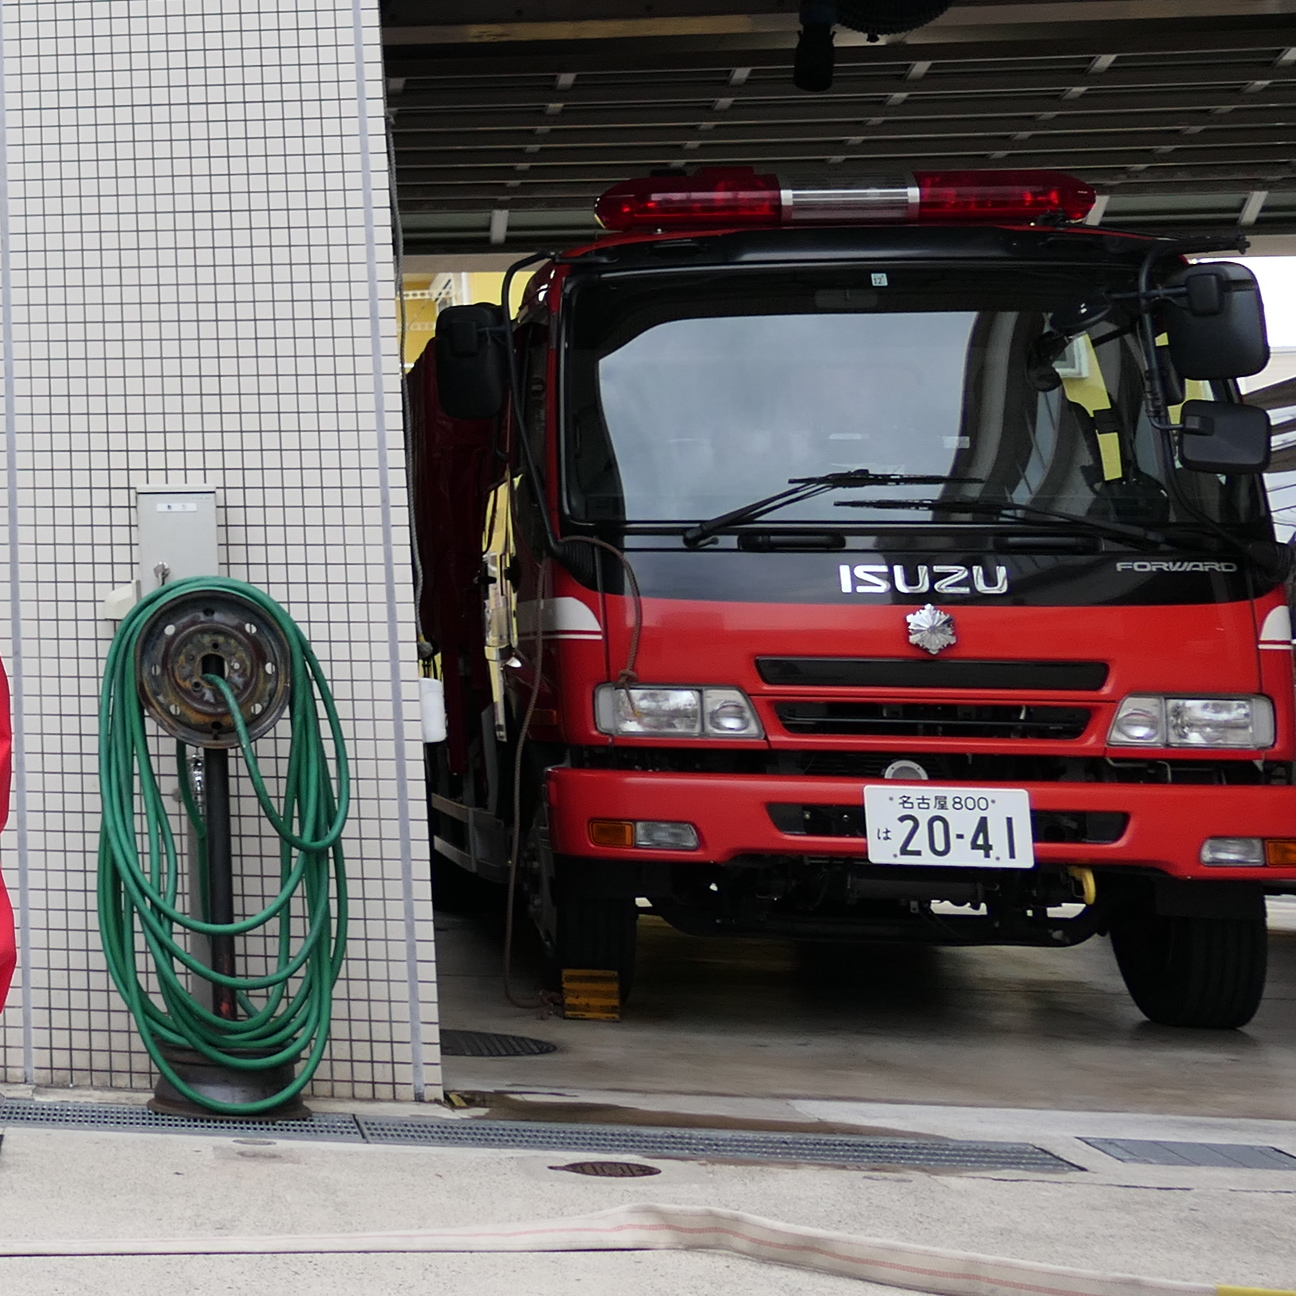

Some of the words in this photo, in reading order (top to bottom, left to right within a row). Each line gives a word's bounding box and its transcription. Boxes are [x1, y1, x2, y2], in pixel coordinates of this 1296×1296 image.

[1116, 561, 1237, 573] FORWARD
[839, 564, 1008, 594] ISUZU
[898, 795, 989, 811] 名古屋800
[877, 827, 892, 841] は
[897, 814, 1016, 859] 20-41
